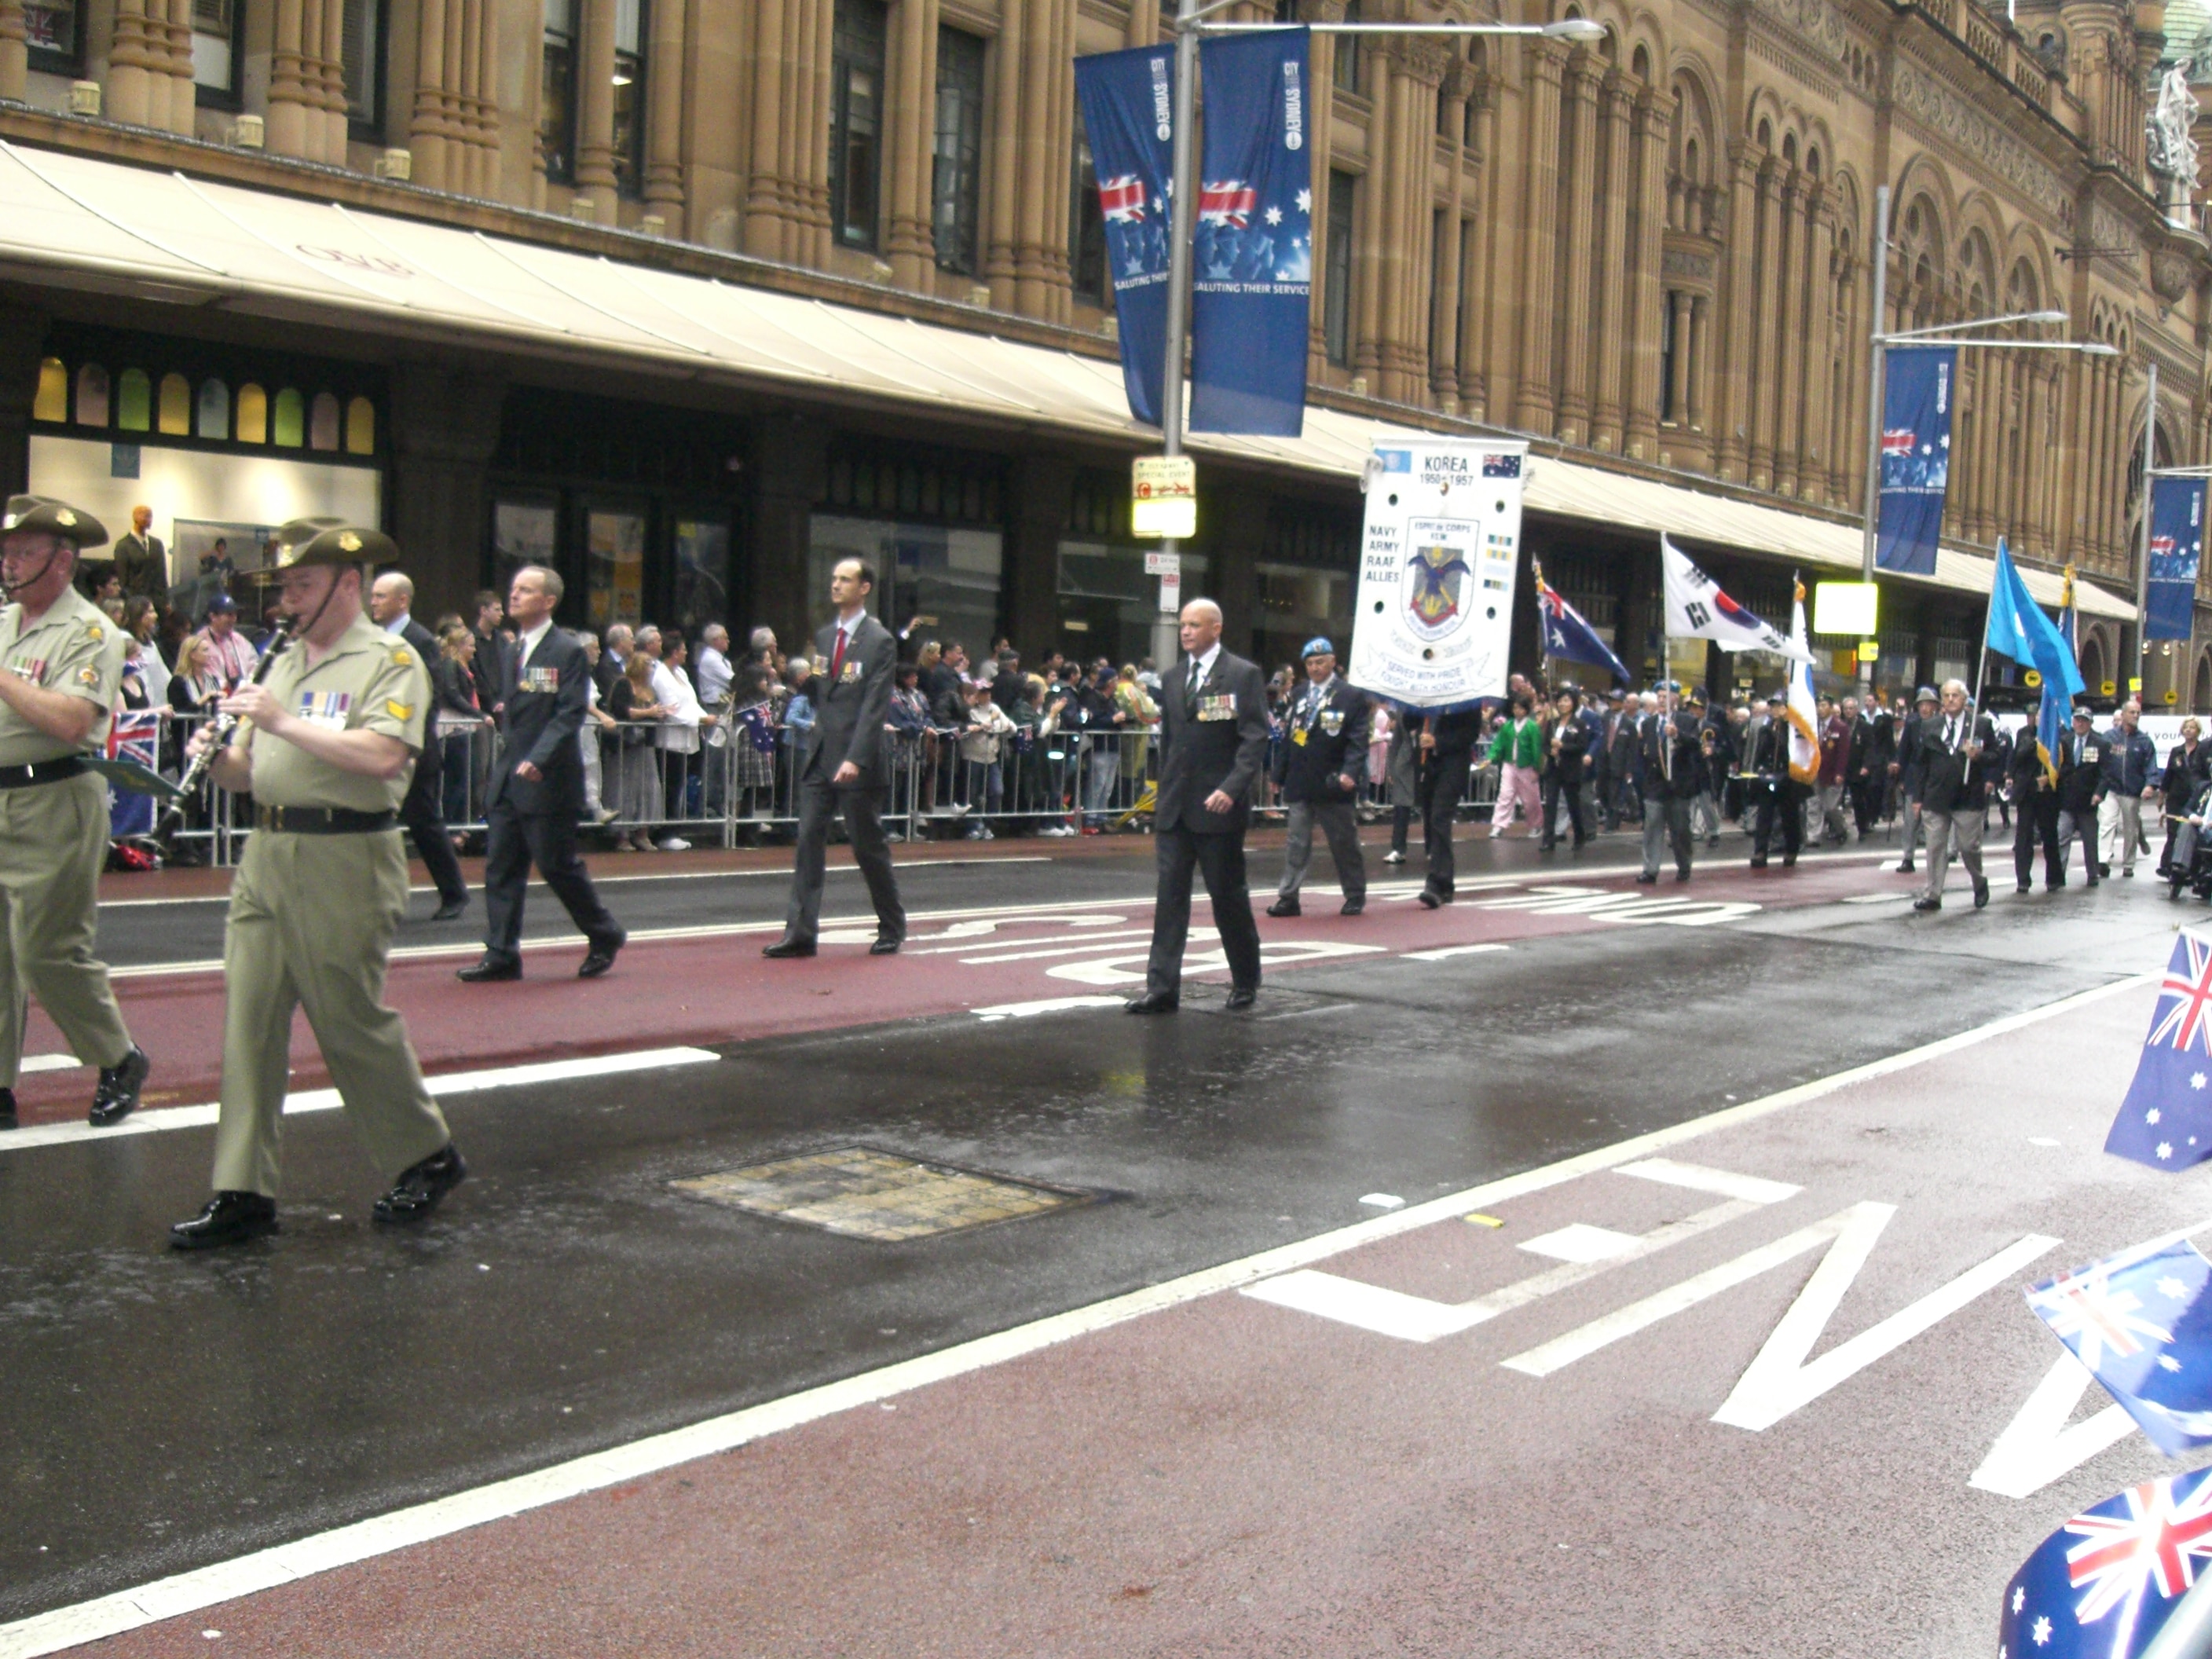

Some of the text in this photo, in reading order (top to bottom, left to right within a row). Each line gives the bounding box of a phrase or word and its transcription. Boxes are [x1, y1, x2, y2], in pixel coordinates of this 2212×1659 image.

[1153, 83, 1170, 123] SYDNEY
[1286, 88, 1302, 133] SYDNEY
[1243, 284, 1271, 294] THEIR
[1273, 284, 1309, 295] SERVICE
[1424, 456, 1468, 473] KOREA
[1369, 525, 1397, 537] NAVY
[1445, 524, 1471, 534] CORPS
[1369, 540, 1400, 553] ARMY
[1367, 555, 1396, 567] RAAF
[1365, 571, 1400, 583] ALLIES
[1387, 661, 1461, 679] SERVED WITH PRIDE
